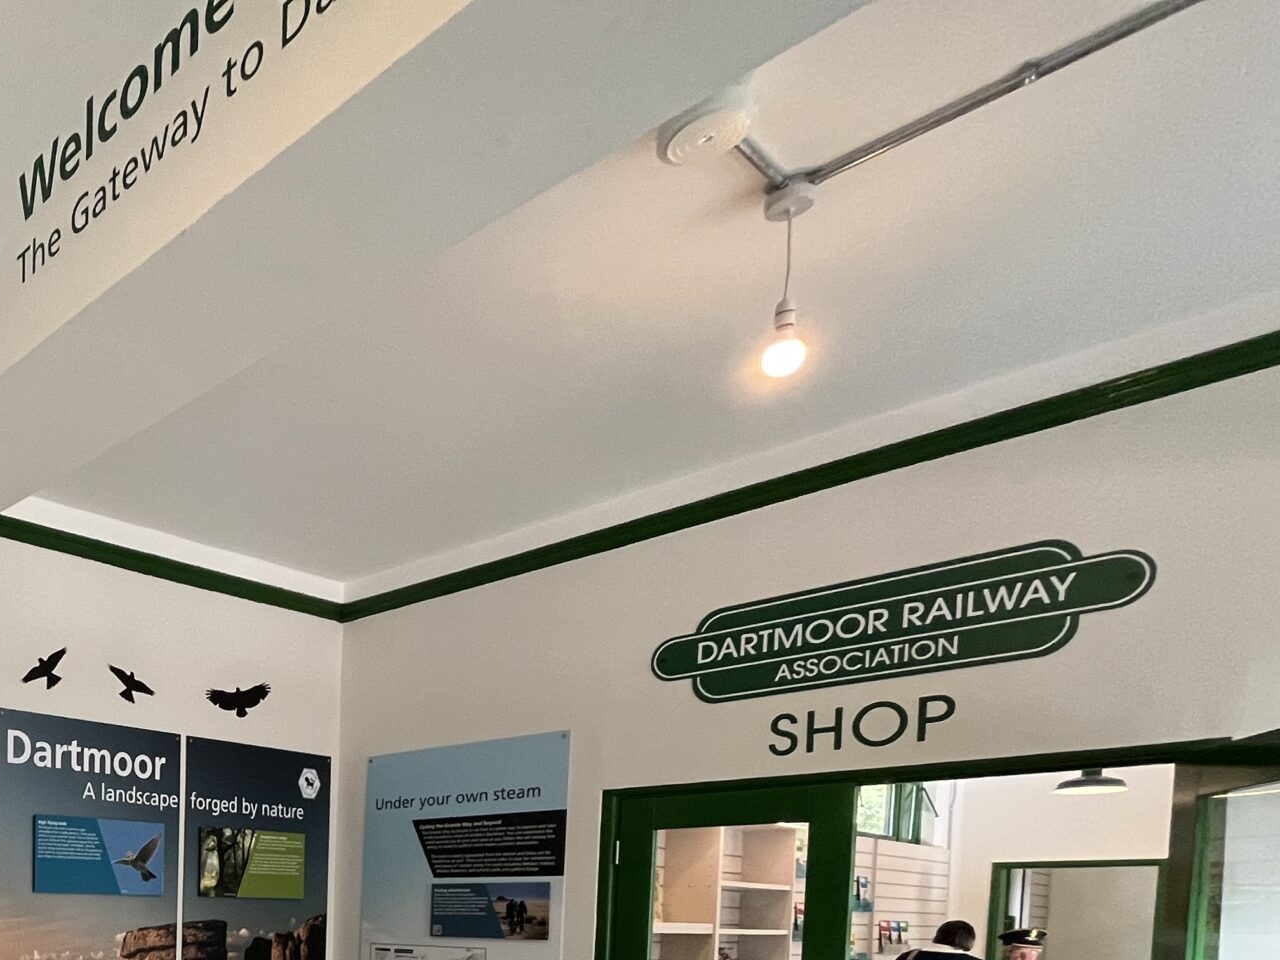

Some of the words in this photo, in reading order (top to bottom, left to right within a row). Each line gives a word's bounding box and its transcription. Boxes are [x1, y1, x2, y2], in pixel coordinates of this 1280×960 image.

[19, 0, 234, 220] Welcome
[17, 226, 61, 284] The
[71, 85, 210, 235] Gateway
[222, 40, 264, 98] to
[697, 608, 888, 665] DARTMOOR
[902, 572, 1078, 629] RAILWAY
[774, 636, 960, 683] ASSOCIATION
[768, 694, 956, 756] SHOP
[7, 729, 166, 781] Dartmoor
[83, 782, 96, 799] A
[101, 782, 178, 811] landscape
[190, 791, 238, 816] forged
[242, 797, 258, 819] by
[262, 803, 304, 820] nature
[375, 795, 415, 811] Under
[419, 794, 452, 811] your
[455, 791, 488, 805] own
[493, 786, 541, 801] steam
